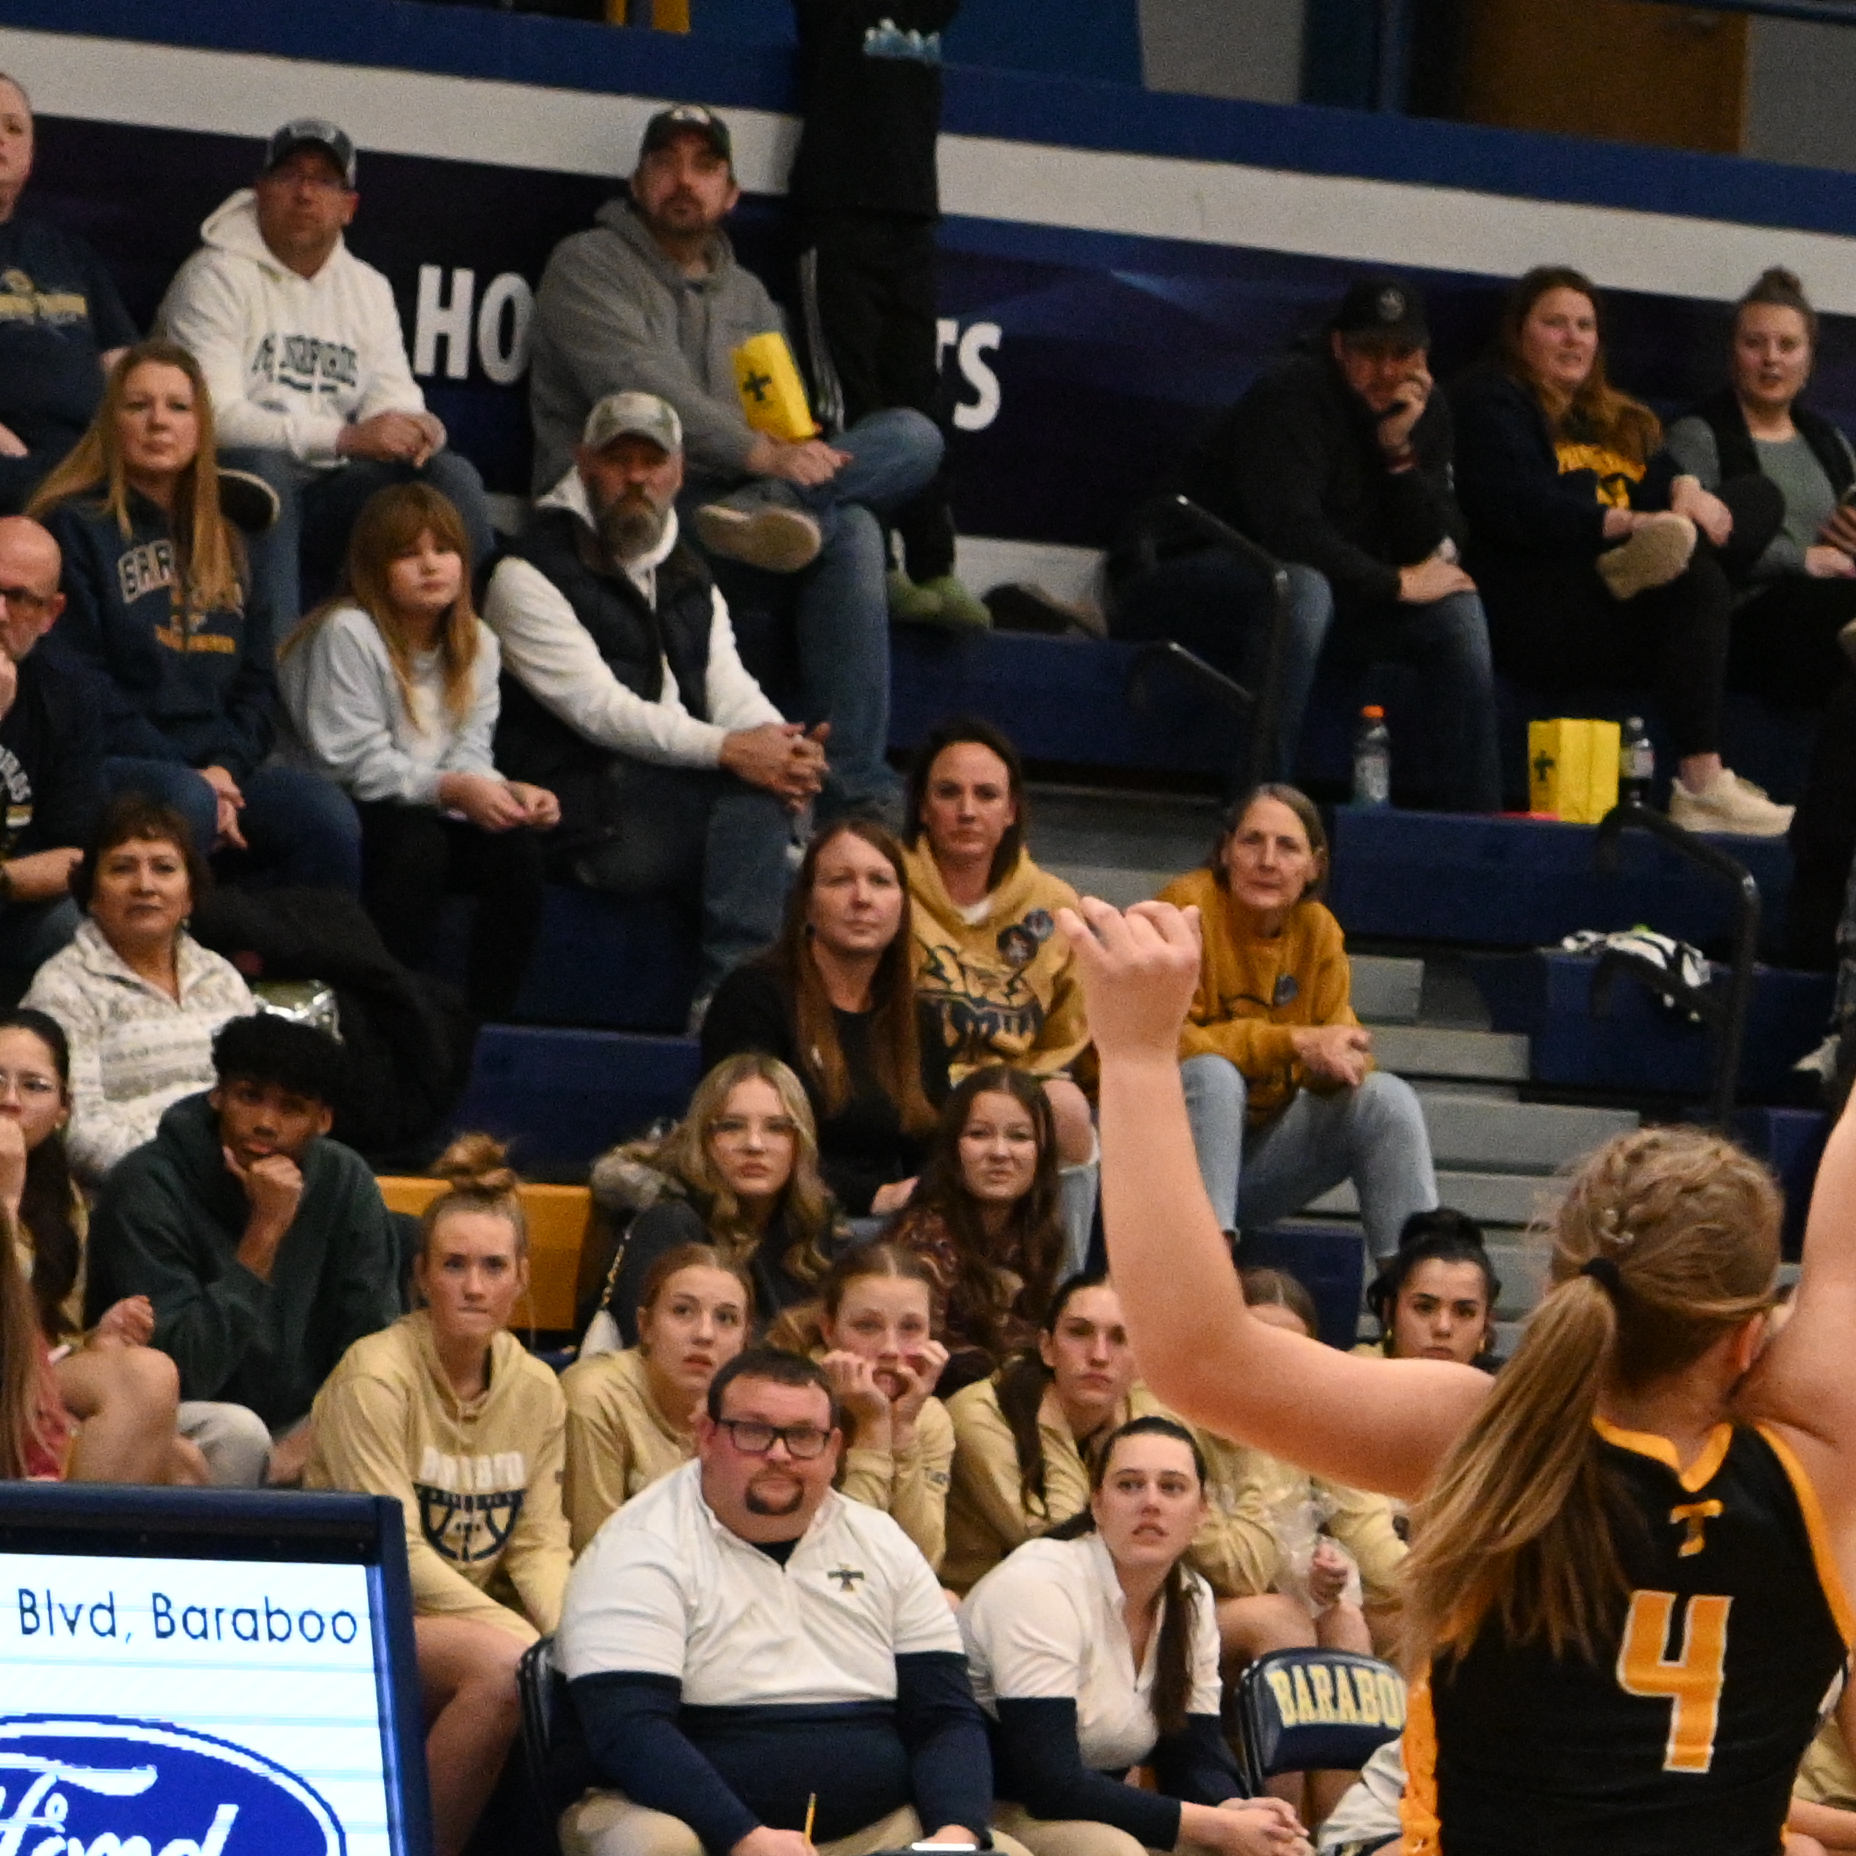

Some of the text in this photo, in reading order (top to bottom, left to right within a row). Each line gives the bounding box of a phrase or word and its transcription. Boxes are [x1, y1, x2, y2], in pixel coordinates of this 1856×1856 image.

[1668, 1498, 1724, 1559] T
[18, 1588, 358, 1645] Blvd, Baraboo
[1267, 1664, 1407, 1731] BARABO
[1615, 1588, 1735, 1774] 4
